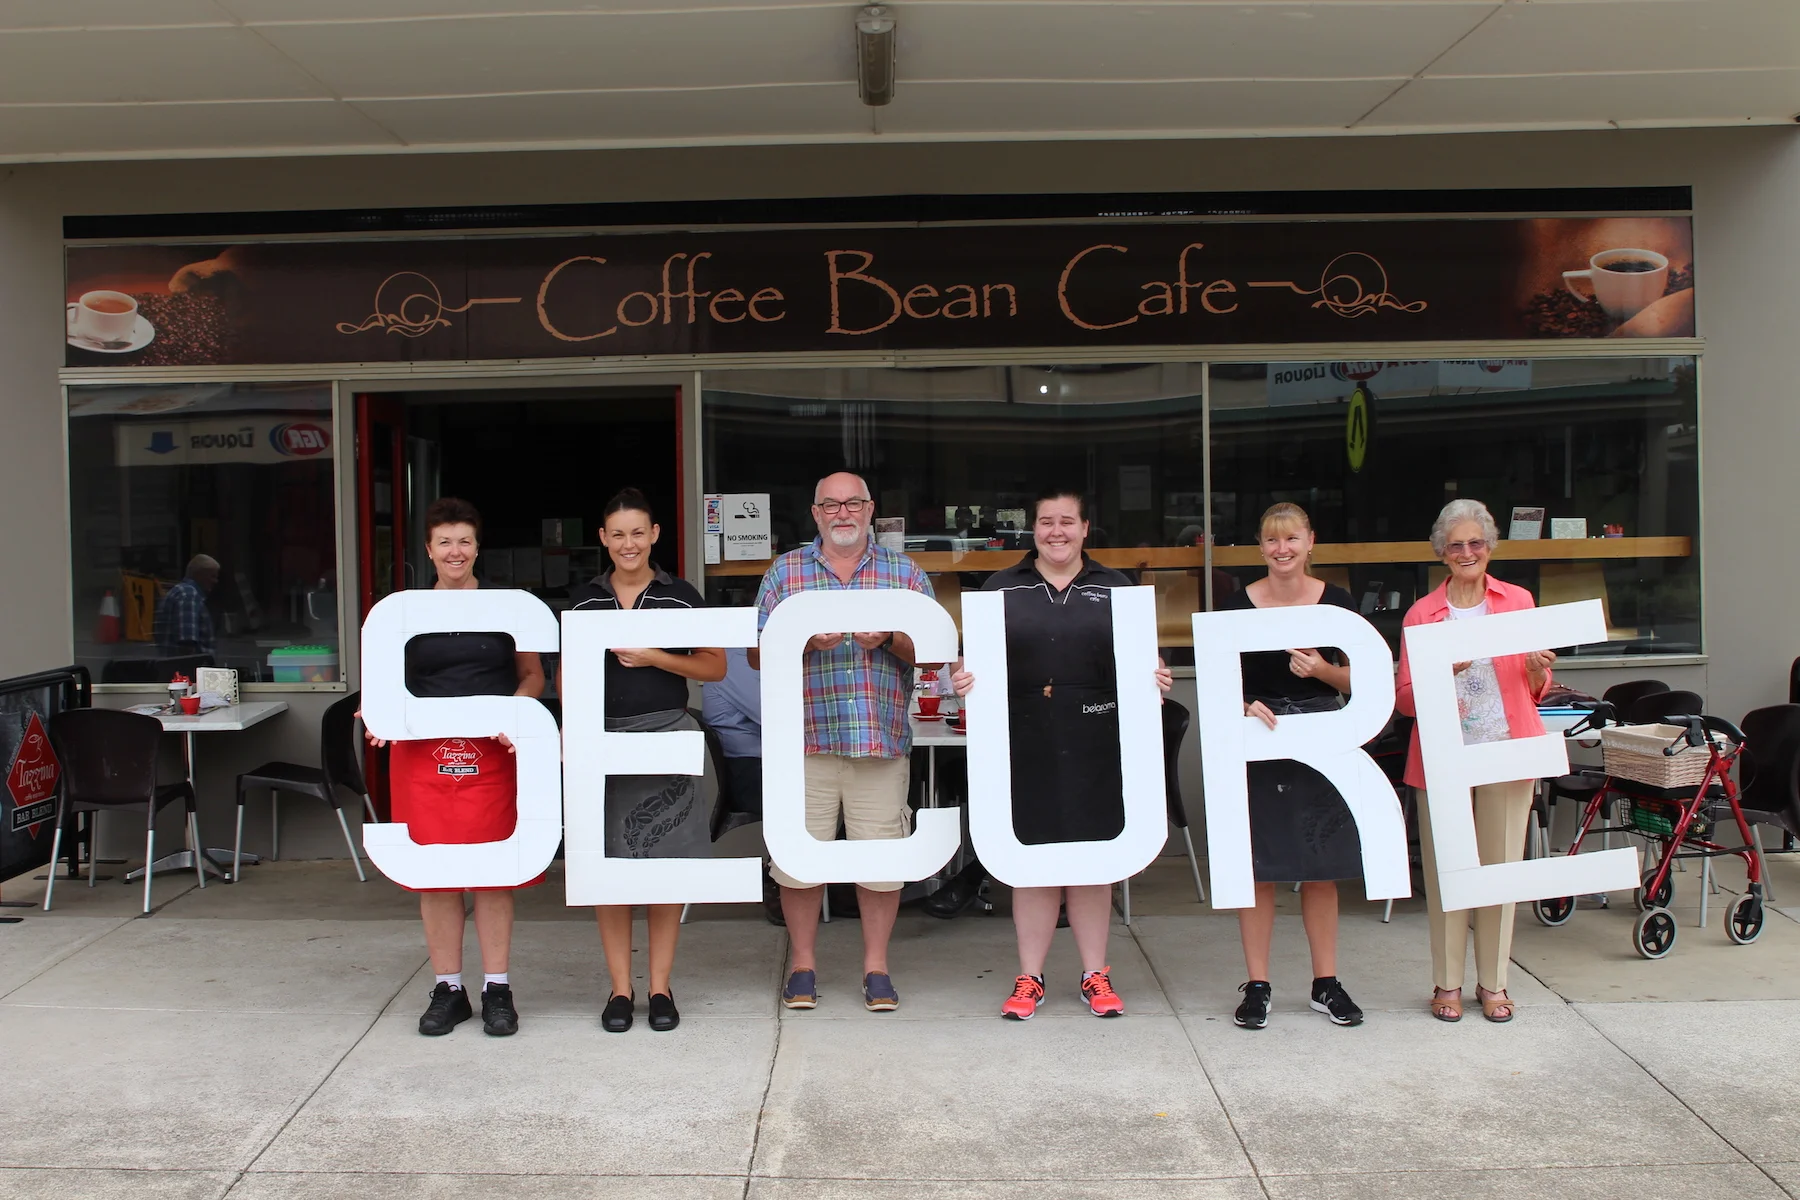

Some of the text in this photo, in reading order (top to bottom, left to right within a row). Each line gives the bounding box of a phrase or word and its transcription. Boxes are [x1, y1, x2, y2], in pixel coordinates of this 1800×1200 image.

[537, 242, 1240, 342] Coffee Bean Cafe
[1082, 701, 1116, 714] belaroma
[362, 585, 1640, 912] SECURE
[440, 747, 476, 762] Tazzina
[16, 759, 55, 792] Tazzina
[16, 803, 53, 824] BAR BLEND
